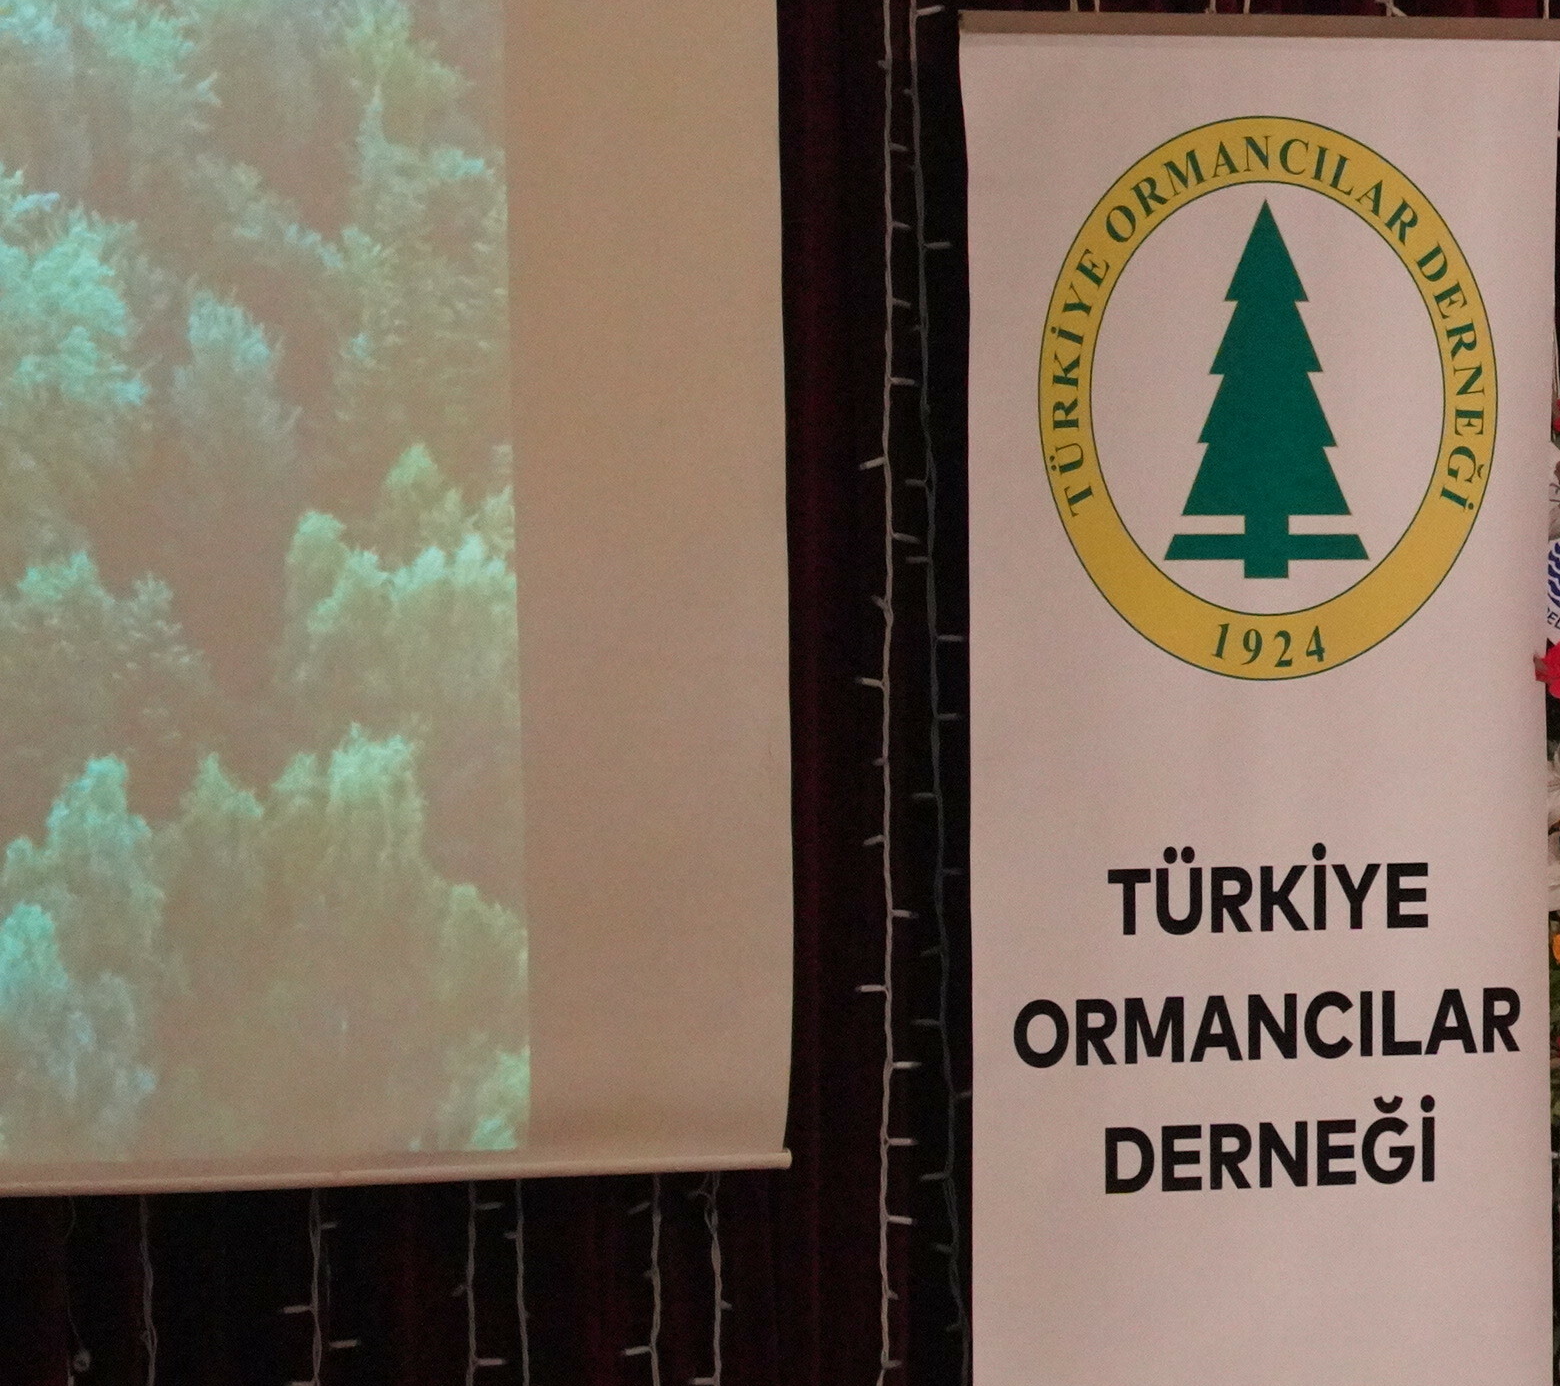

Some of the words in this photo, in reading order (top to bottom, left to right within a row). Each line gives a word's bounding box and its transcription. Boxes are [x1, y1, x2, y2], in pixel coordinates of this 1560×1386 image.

[1049, 248, 1110, 518] TÜRKİYE
[1106, 135, 1420, 247] ORMANCILAR
[1416, 241, 1487, 513] DERNEĞİ
[1211, 622, 1326, 669] 1924
[1107, 842, 1430, 936] TÜRKİYE
[1013, 986, 1521, 1068] ORMANCILAR
[1104, 1095, 1437, 1195] DERNEĞİ
